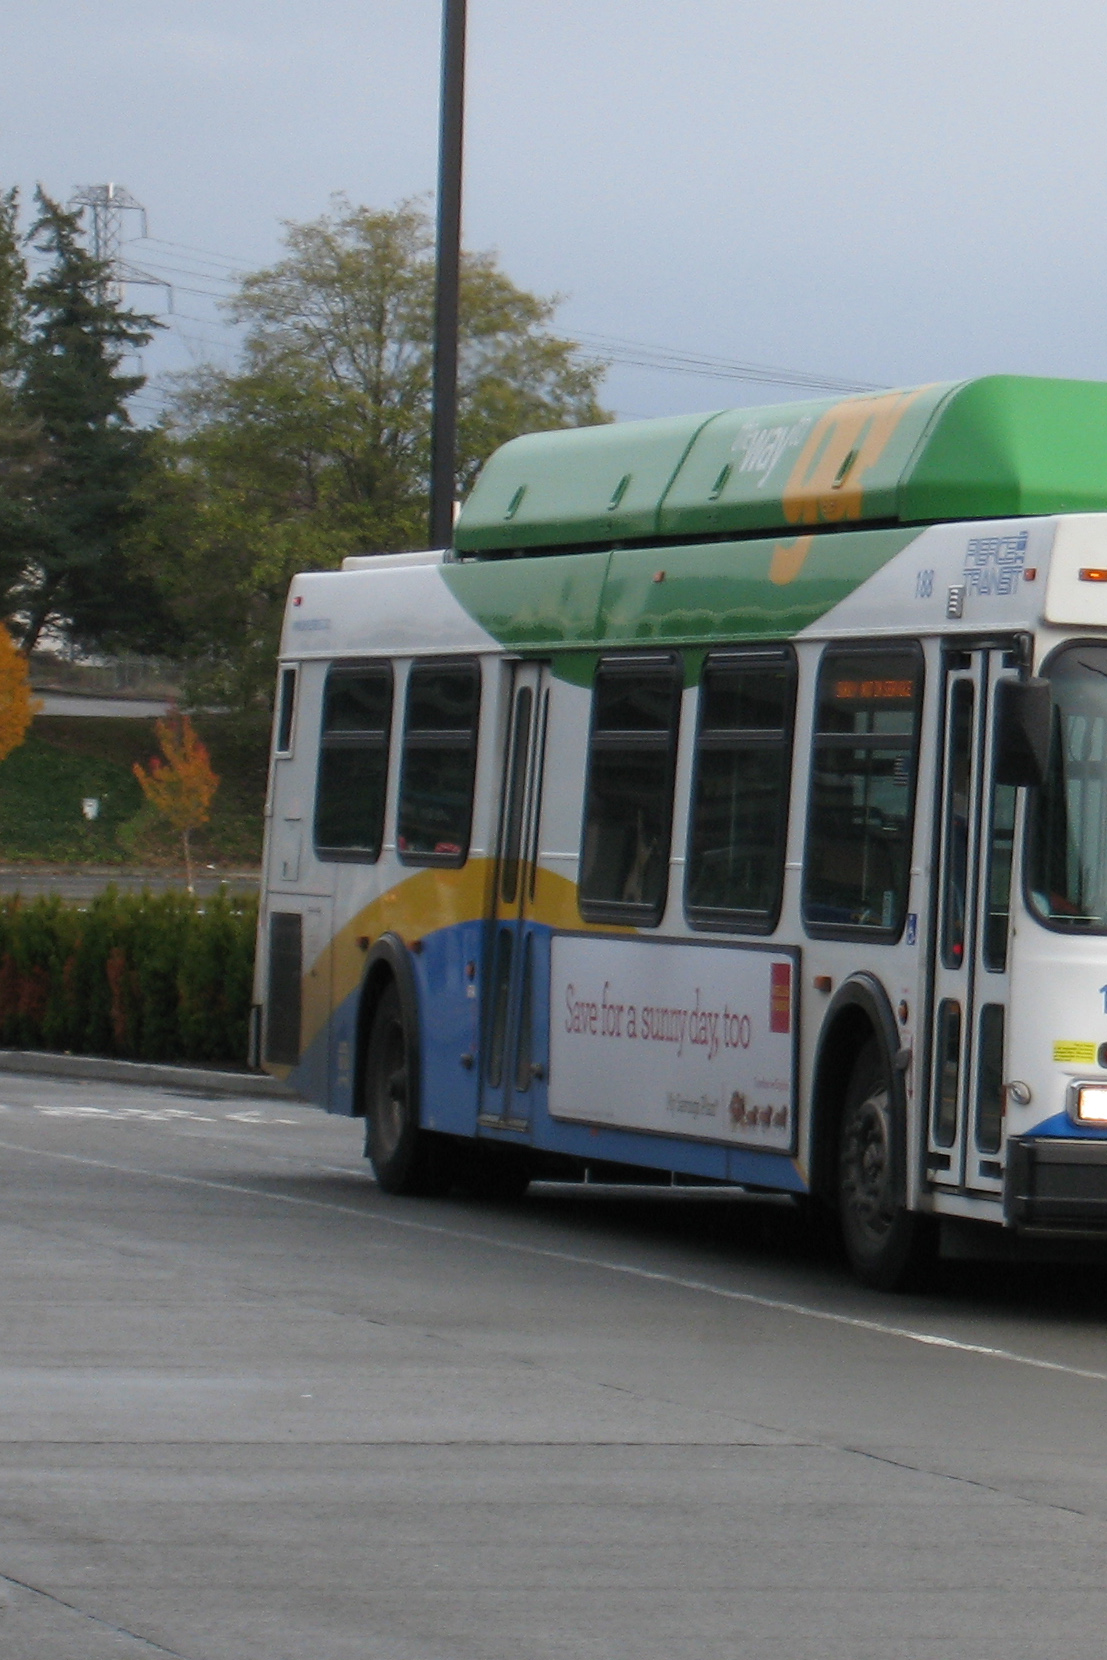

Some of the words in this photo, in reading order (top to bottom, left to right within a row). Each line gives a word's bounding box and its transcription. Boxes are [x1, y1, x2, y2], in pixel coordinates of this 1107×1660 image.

[565, 983, 598, 1036] Save
[601, 981, 624, 1037] for
[626, 1005, 637, 1039] a
[641, 1006, 687, 1058] sunny
[724, 1004, 750, 1049] too
